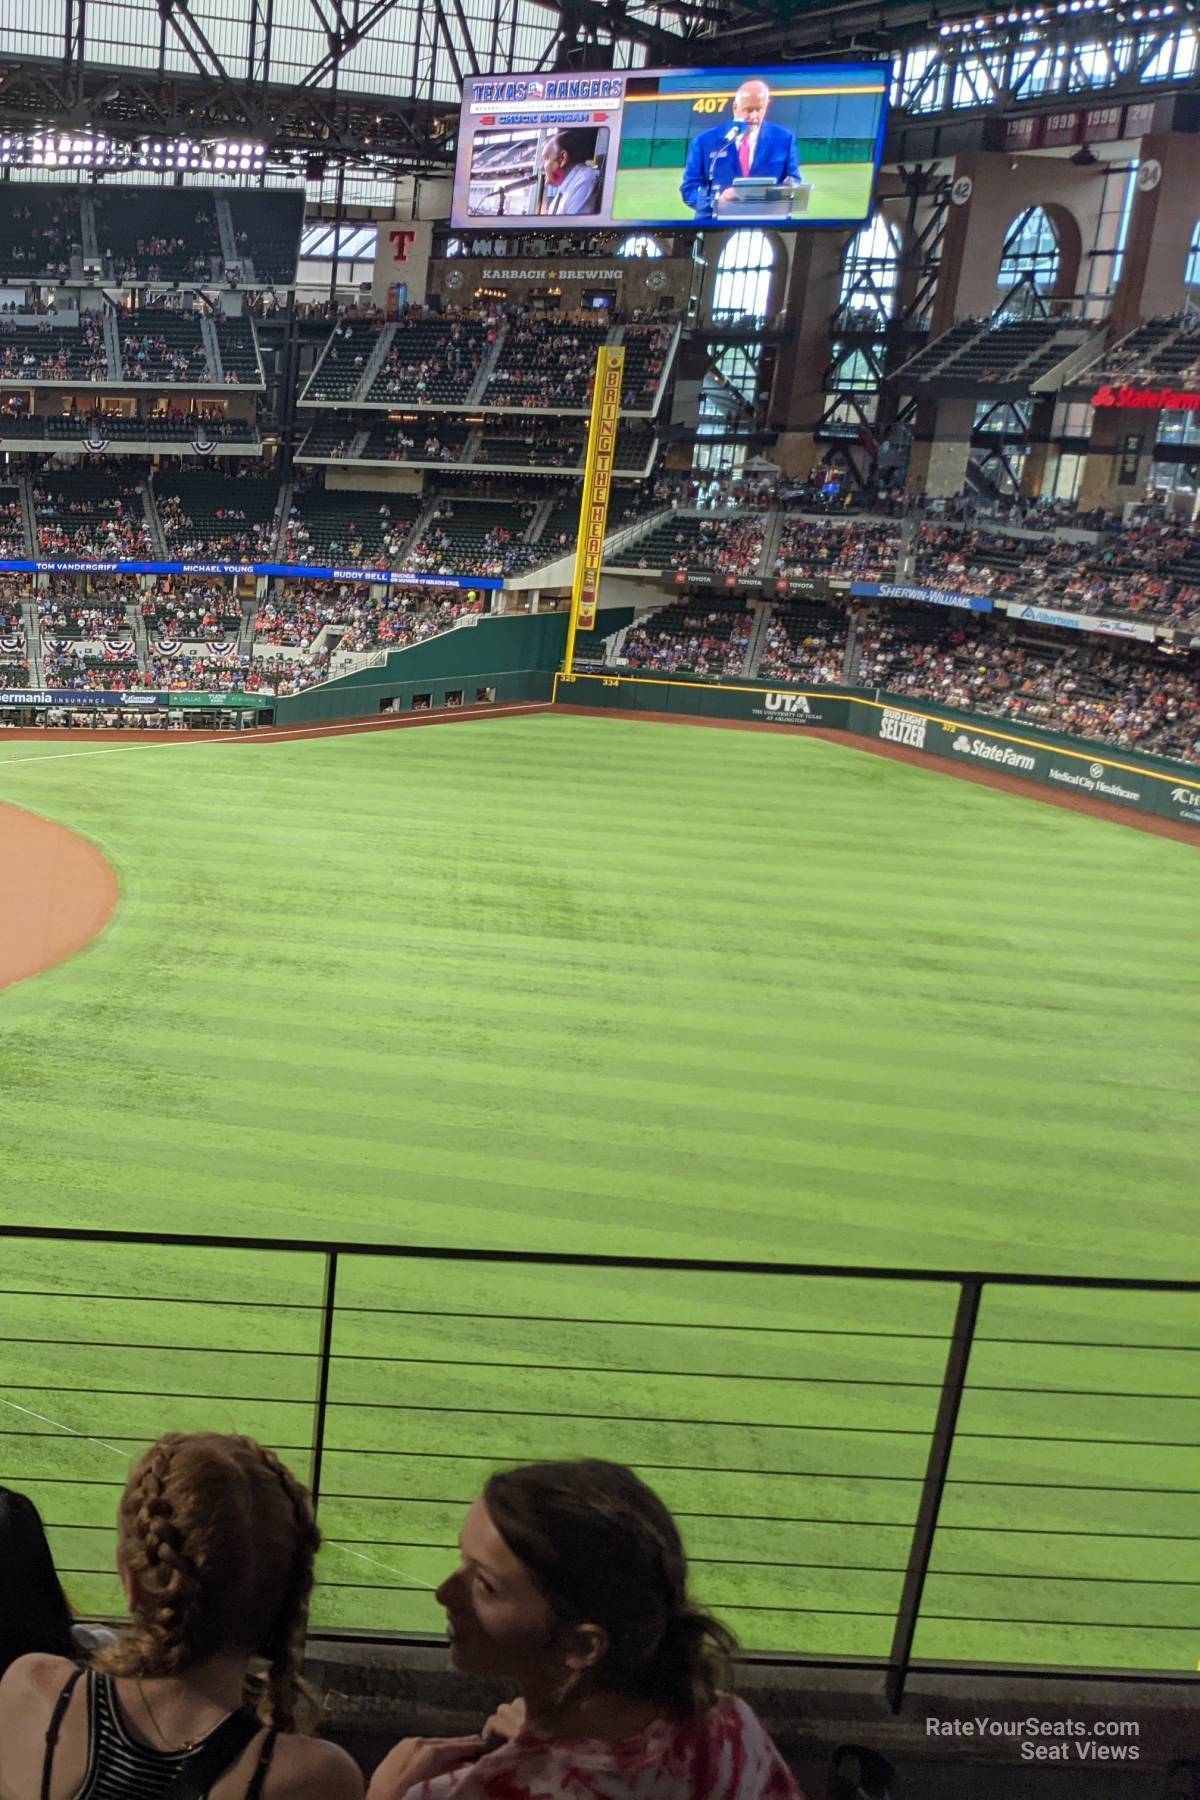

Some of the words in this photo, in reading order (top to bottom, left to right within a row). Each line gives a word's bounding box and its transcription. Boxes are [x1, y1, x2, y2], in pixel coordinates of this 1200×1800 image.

[472, 80, 526, 101] TEXAS
[544, 77, 623, 99] RANGERS
[692, 98, 728, 113] 407
[497, 114, 537, 124] CHUCK
[1140, 164, 1158, 184] 34
[954, 182, 969, 198] 42
[390, 231, 415, 261] T
[483, 269, 546, 279] KARBACH
[558, 269, 624, 279] BREWING
[600, 374, 617, 450] BRING
[596, 457, 608, 502] THE
[589, 508, 603, 567] HEAT
[183, 565, 222, 573] MICHAEL
[333, 571, 363, 580] BUDDY
[365, 573, 388, 581] BELL
[877, 584, 971, 609] SHERWIN-WILLIAMS
[1098, 620, 1112, 629] Tom
[602, 678, 619, 687] 334
[765, 693, 811, 714] UTA
[764, 710, 796, 718] UNIVERSITY
[883, 708, 901, 721] BUD
[902, 712, 928, 726] LIGHT
[880, 717, 927, 749] SELTZER
[971, 739, 1036, 770] StateFarm
[1049, 768, 1080, 785] Medical
[1079, 775, 1096, 790] City
[1095, 780, 1141, 801] Healthcare
